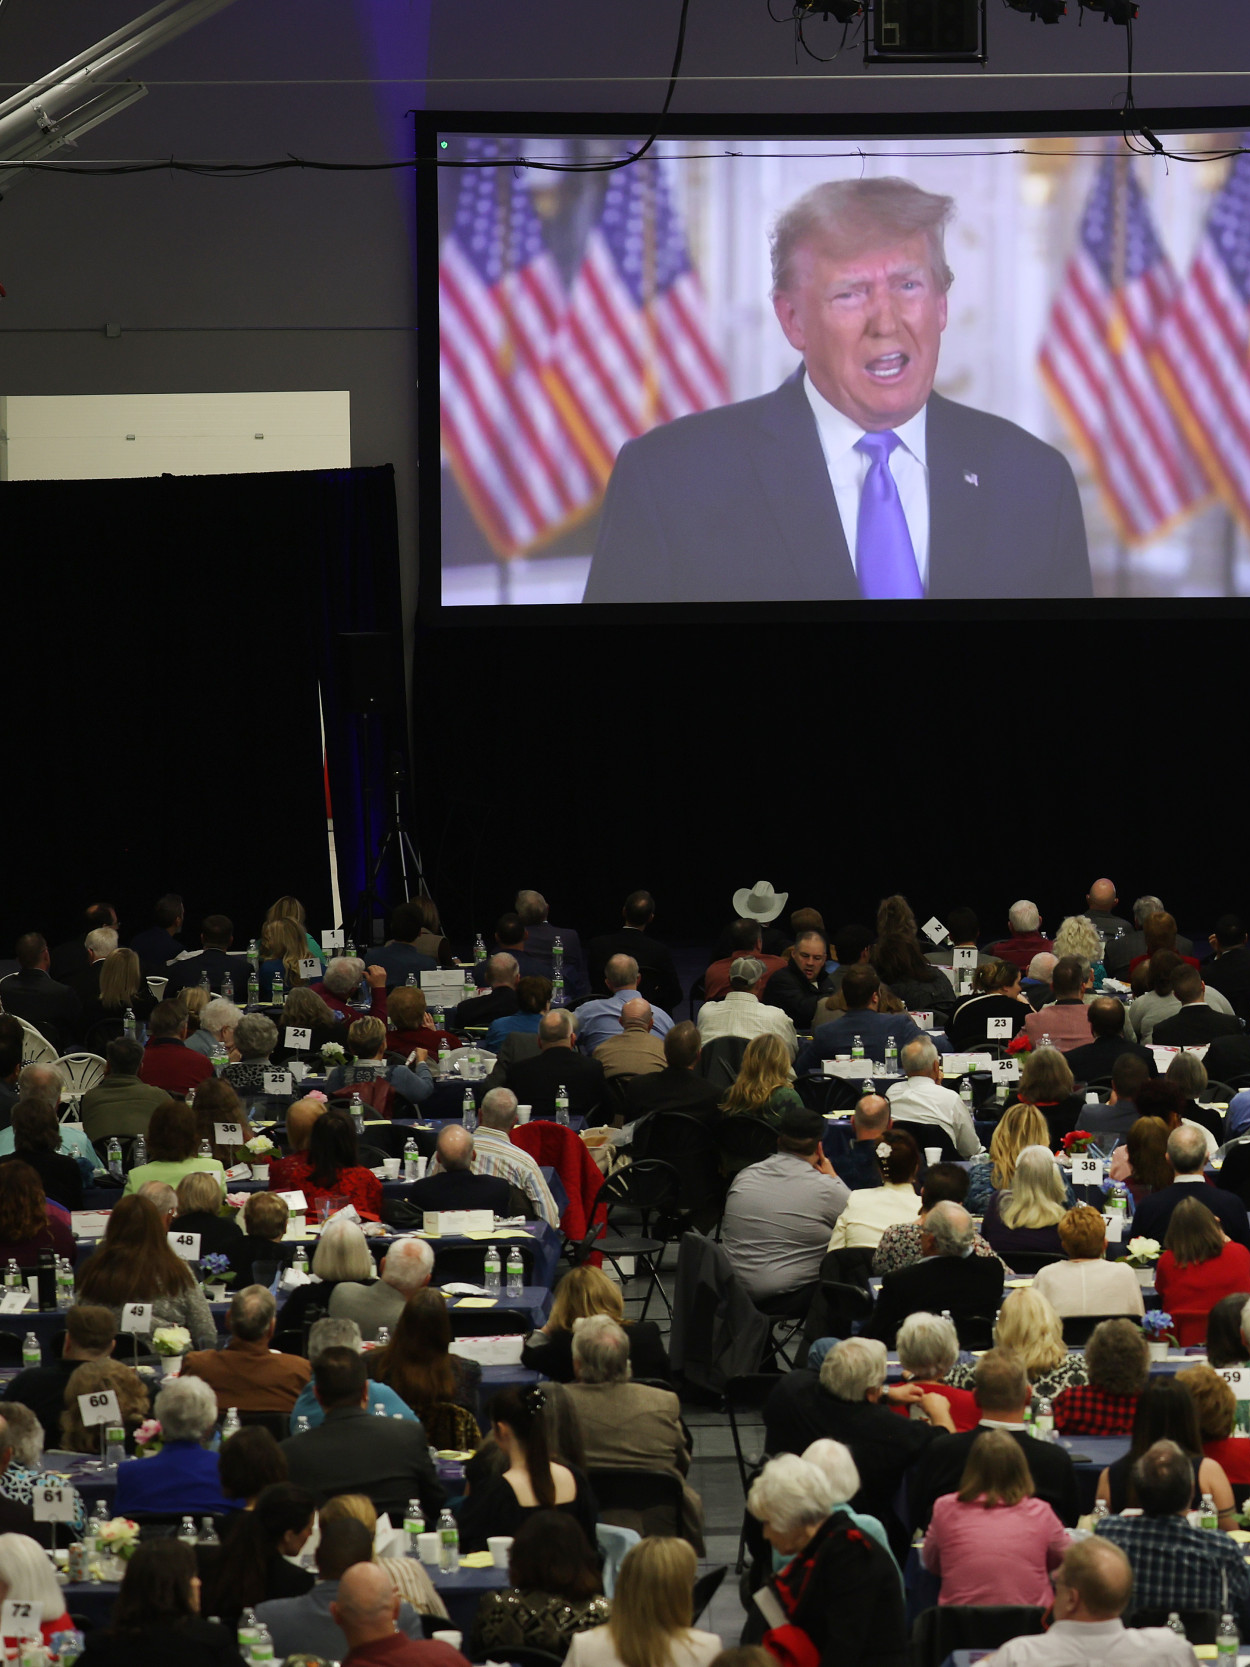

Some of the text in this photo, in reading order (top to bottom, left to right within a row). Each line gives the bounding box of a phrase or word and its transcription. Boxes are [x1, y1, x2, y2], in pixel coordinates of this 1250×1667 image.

[934, 923, 944, 932] 2
[995, 1019, 1006, 1027] 23
[293, 1029, 306, 1037] 24
[999, 1061, 1012, 1070] 26
[271, 1074, 284, 1082] 25
[222, 1124, 236, 1132] 36
[1082, 1162, 1096, 1170] 38
[177, 1235, 193, 1245] 48
[131, 1306, 144, 1316] 49
[1223, 1372, 1241, 1382] 59
[90, 1394, 108, 1407] 60
[44, 1492, 63, 1502] 61
[12, 1604, 32, 1616] 72
